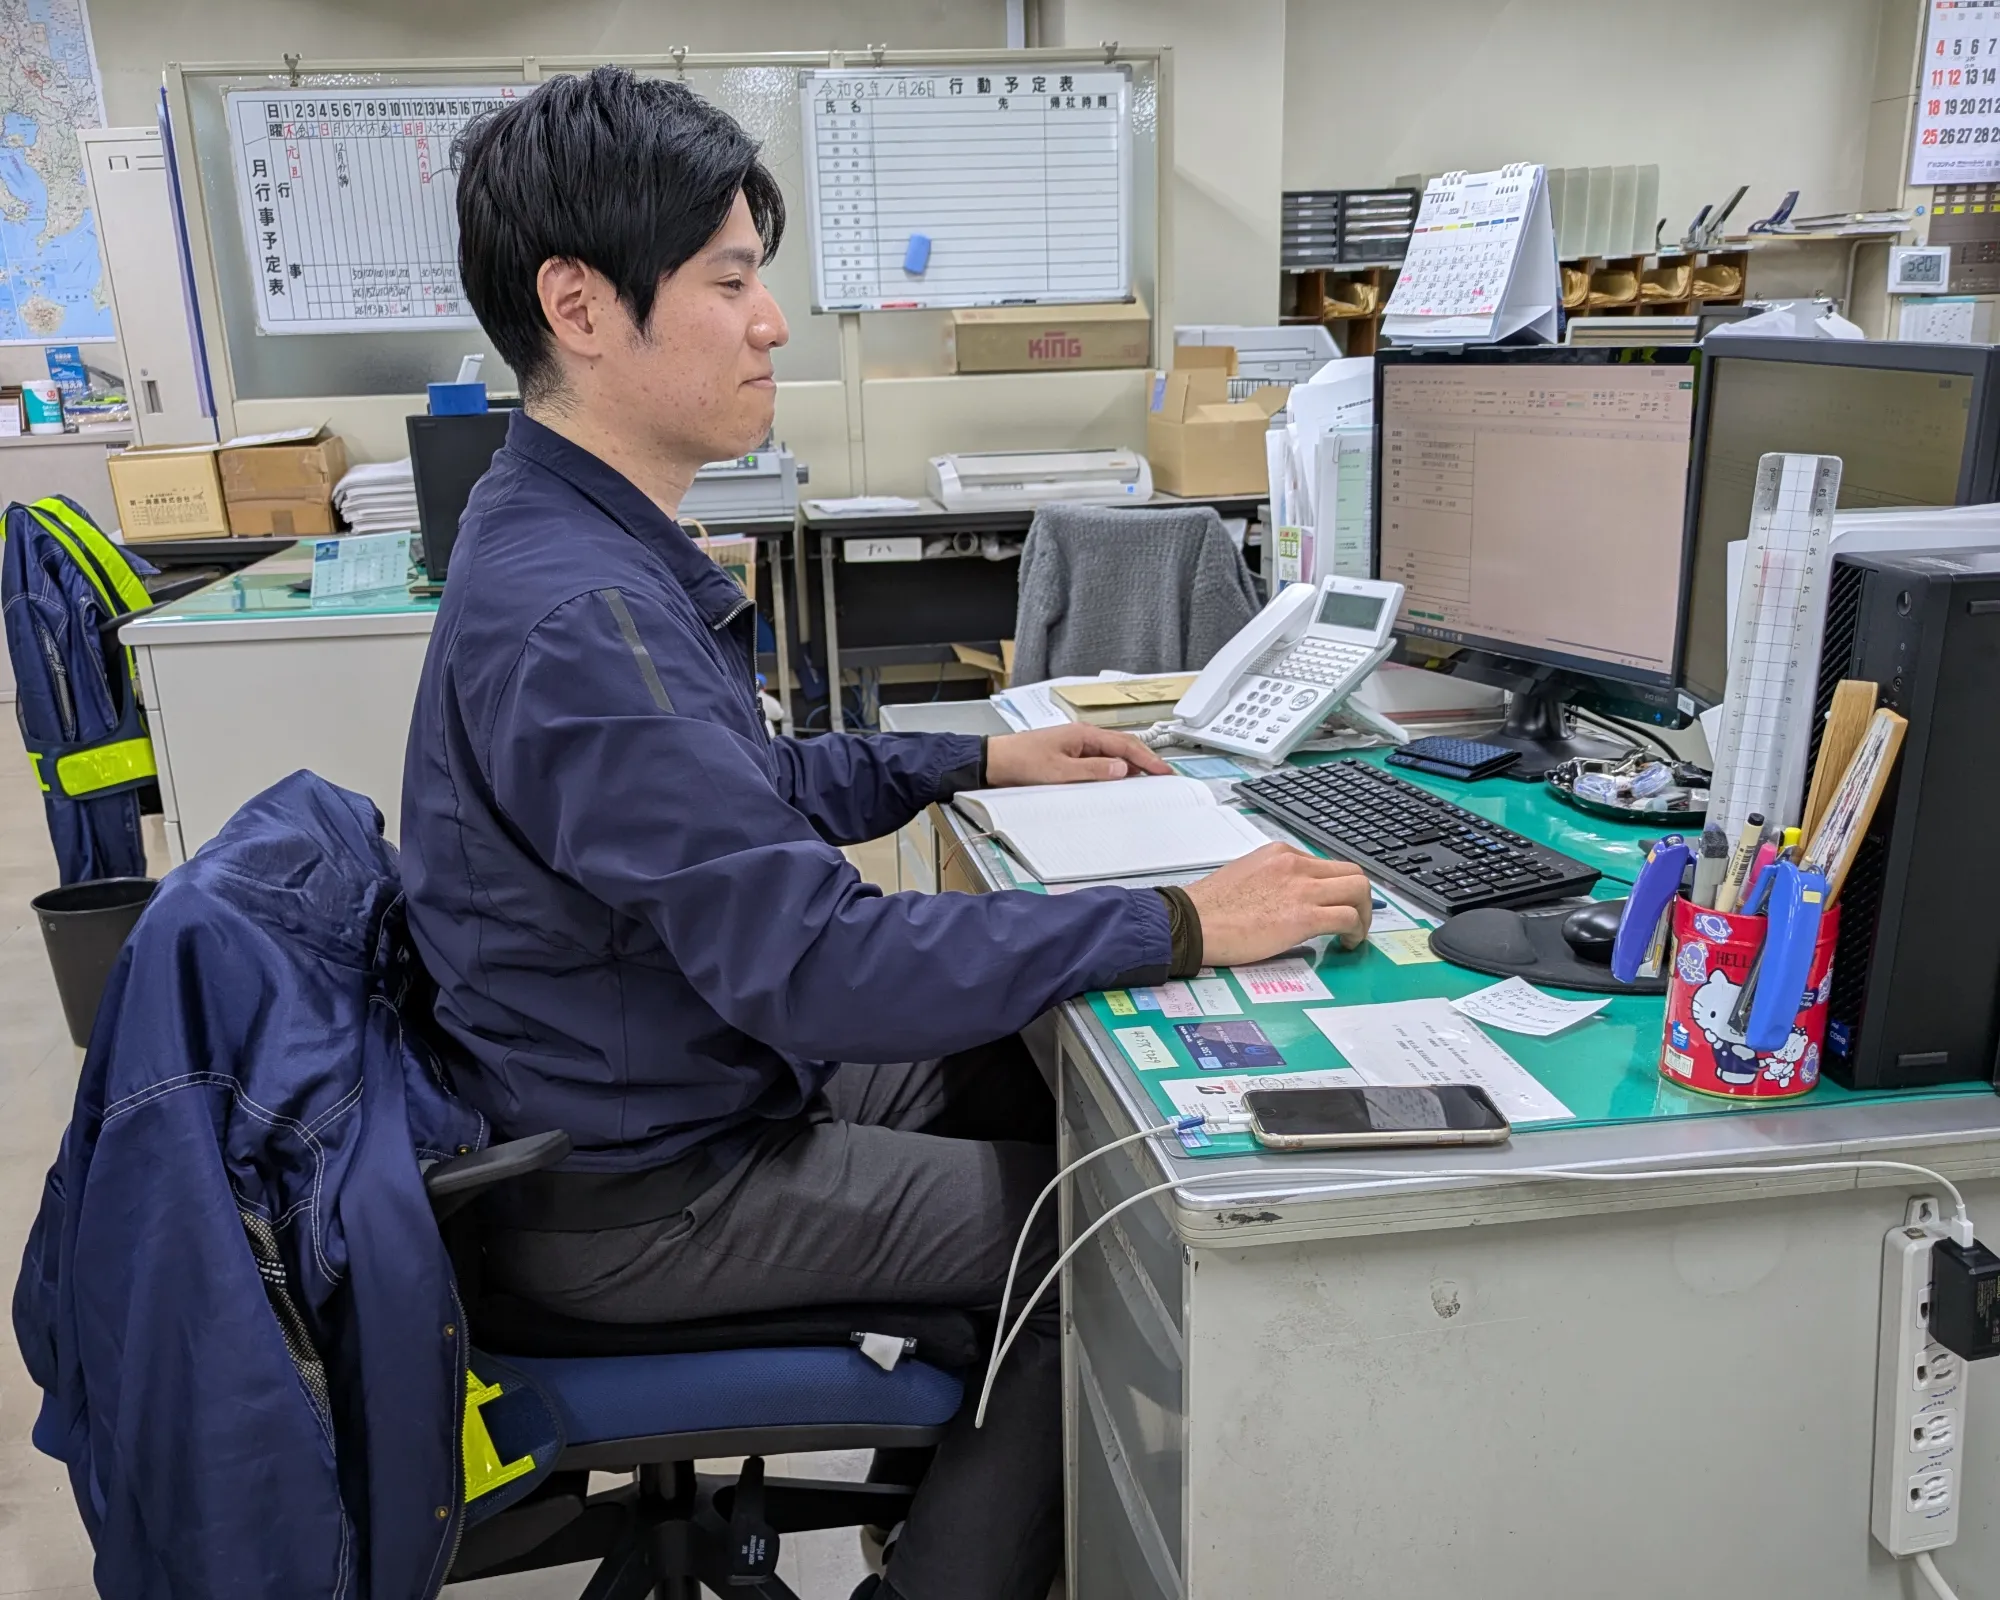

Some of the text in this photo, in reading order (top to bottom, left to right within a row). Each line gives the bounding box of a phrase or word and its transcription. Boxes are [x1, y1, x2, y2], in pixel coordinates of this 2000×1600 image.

[1936, 38, 1998, 56] 4 5 6 7
[949, 76, 1074, 94] 行動予定表
[1932, 68, 1996, 86] 11 12 13 14
[267, 103, 280, 118] 日
[284, 104, 289, 118] 1
[295, 103, 304, 118] 2
[307, 103, 316, 118] 3
[319, 103, 328, 117] 4
[331, 103, 340, 117] 5
[343, 103, 351, 117] 6
[354, 103, 362, 117] 7
[367, 102, 375, 117] 8
[378, 102, 387, 117] 9
[390, 102, 400, 117] 10
[402, 102, 412, 116] 11
[414, 102, 424, 116] 12
[425, 102, 435, 116] 13
[436, 102, 446, 116] 14
[448, 102, 458, 115] 15
[459, 101, 470, 115] 16
[472, 101, 481, 114] 17
[826, 100, 861, 114] 氏名
[1928, 97, 2000, 116] 18 19 20 21 2
[270, 124, 283, 137] 曜
[320, 123, 330, 136] 日
[403, 122, 413, 136] 日
[1922, 129, 1938, 145] 25
[1939, 128, 1955, 145] 26
[1956, 128, 1972, 144] 27
[1974, 127, 1989, 143] 28
[252, 159, 285, 297] 月行事予定表
[1028, 337, 1082, 360] KING
[1716, 951, 1751, 969] HELL
